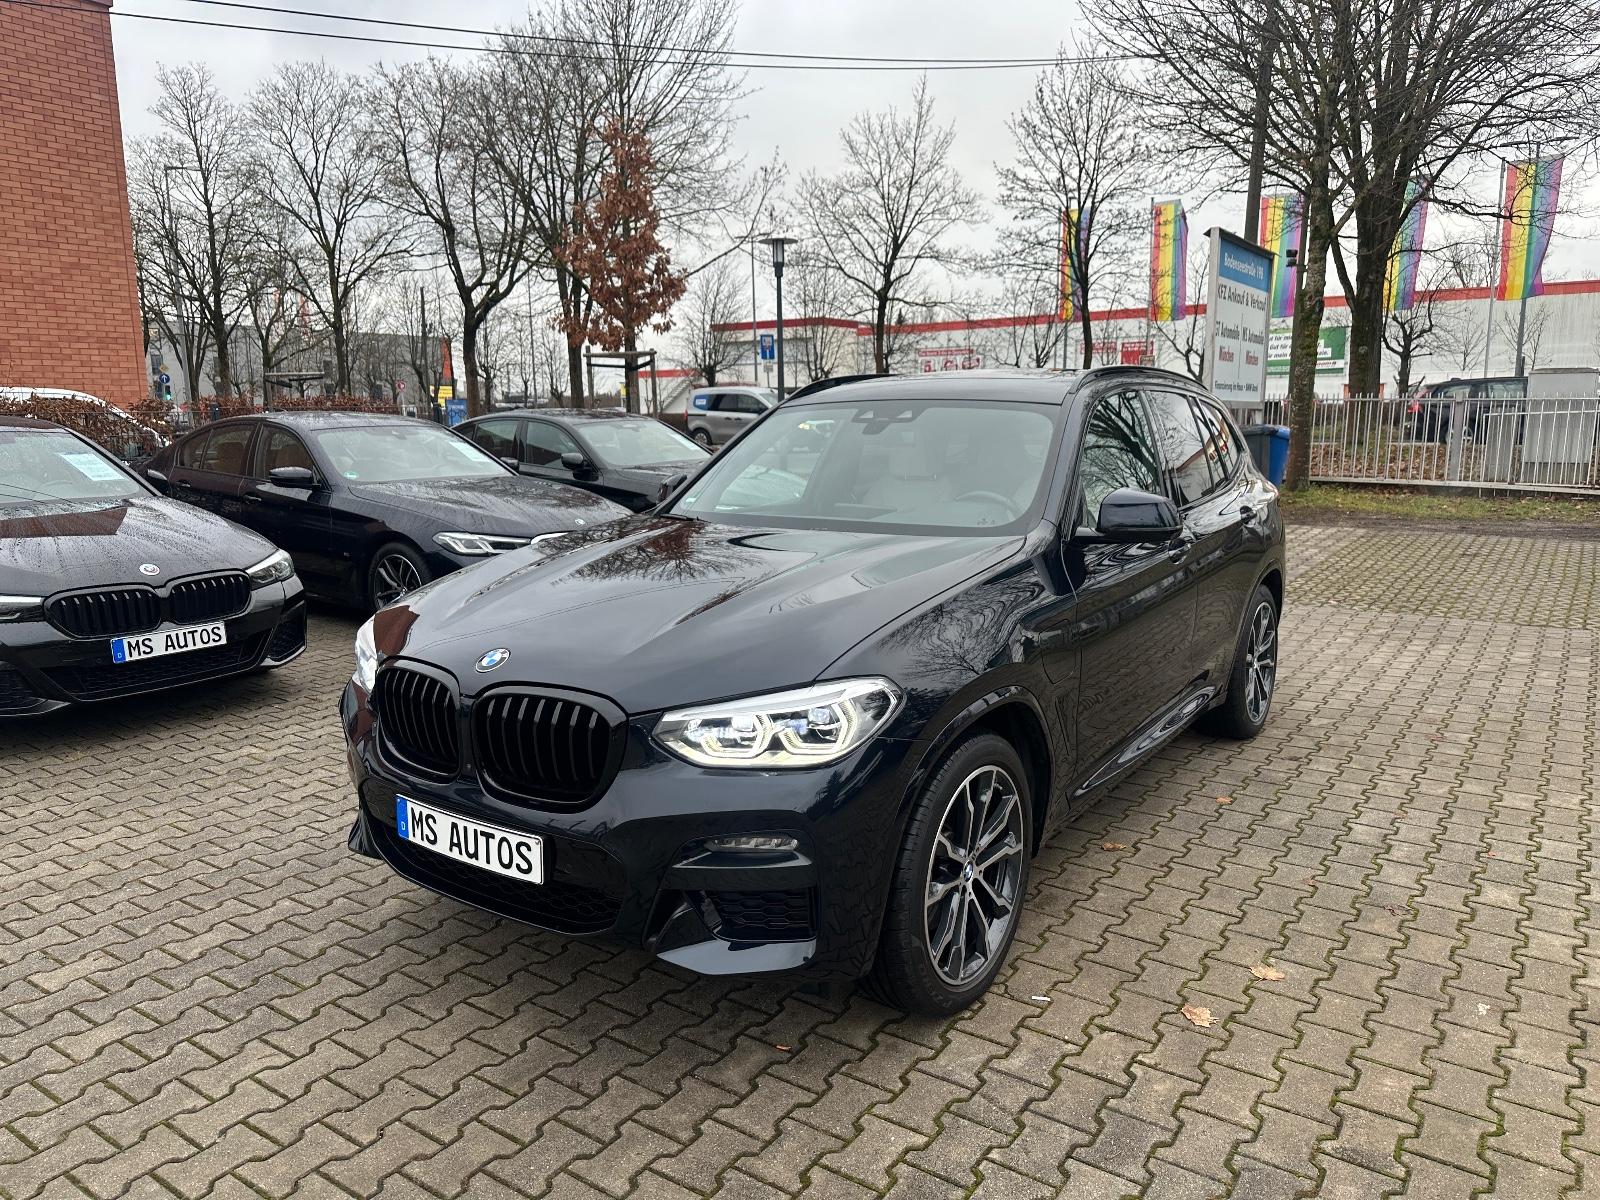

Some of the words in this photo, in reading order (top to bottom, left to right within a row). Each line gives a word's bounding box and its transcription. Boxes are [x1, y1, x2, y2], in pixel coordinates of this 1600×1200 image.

[1227, 286, 1246, 305] Ankauf
[1250, 293, 1267, 312] Verkauf
[127, 637, 154, 658] MS
[164, 626, 222, 652] AUTOS
[410, 806, 438, 846] MS
[448, 821, 533, 875] AUTOS
